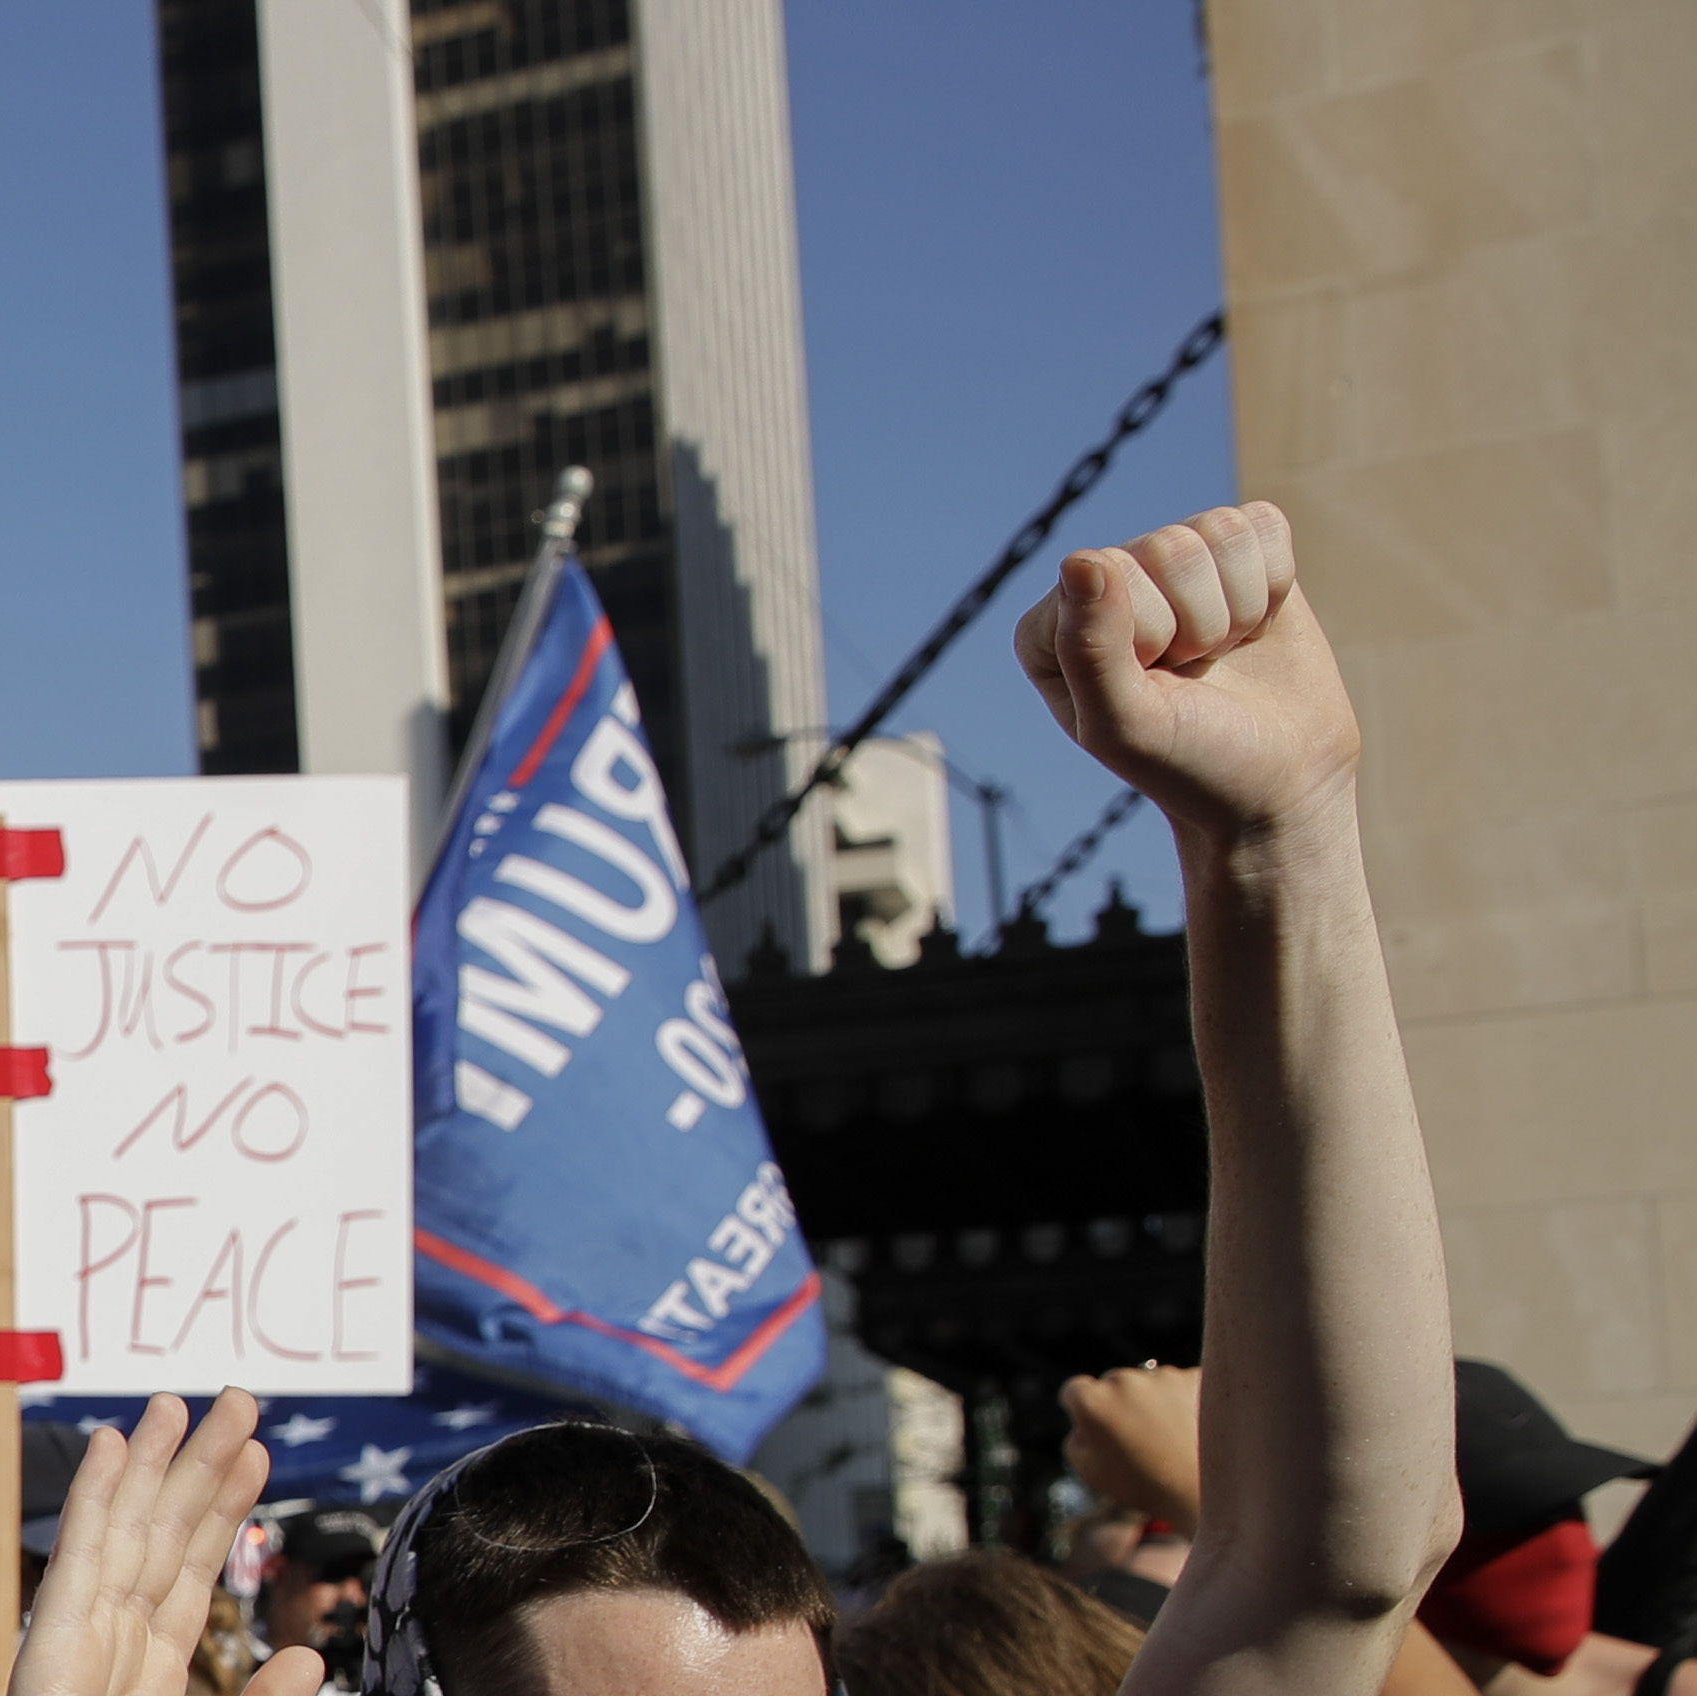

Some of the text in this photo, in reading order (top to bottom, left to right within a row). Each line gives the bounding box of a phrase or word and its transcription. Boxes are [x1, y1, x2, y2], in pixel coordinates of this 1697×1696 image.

[88, 812, 313, 925] NO
[53, 939, 390, 1062] JUSTICE
[113, 1076, 309, 1163] NO
[75, 1193, 384, 1363] PEACE
